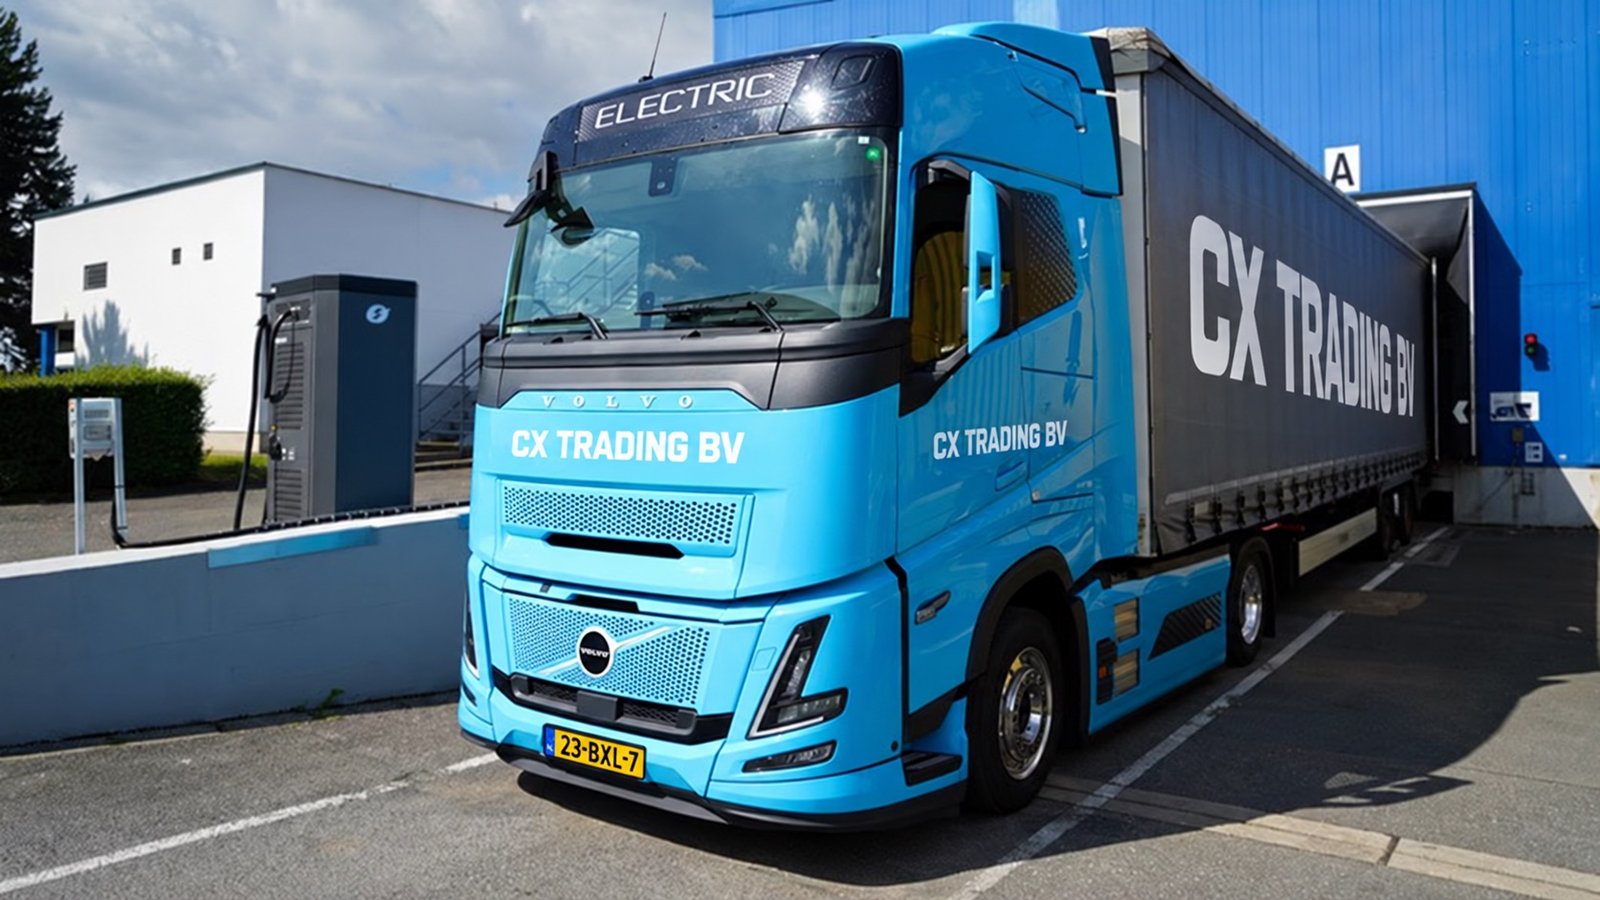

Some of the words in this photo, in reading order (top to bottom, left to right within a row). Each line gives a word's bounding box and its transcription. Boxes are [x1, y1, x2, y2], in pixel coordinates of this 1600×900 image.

[594, 72, 776, 129] ELECTRIC
[1330, 152, 1355, 187] A
[1189, 214, 1267, 387] CX
[1276, 259, 1392, 414] TRADING
[1397, 333, 1415, 417] BV
[543, 394, 694, 409] VOLVO
[511, 429, 549, 459] CX
[556, 430, 689, 463] TRADING
[698, 431, 745, 464] BV
[933, 430, 960, 460] CX
[965, 422, 1040, 456] TRADING
[1045, 420, 1068, 447] BV
[580, 646, 610, 659] VOLVO
[560, 734, 639, 772] 23-BXL-7
